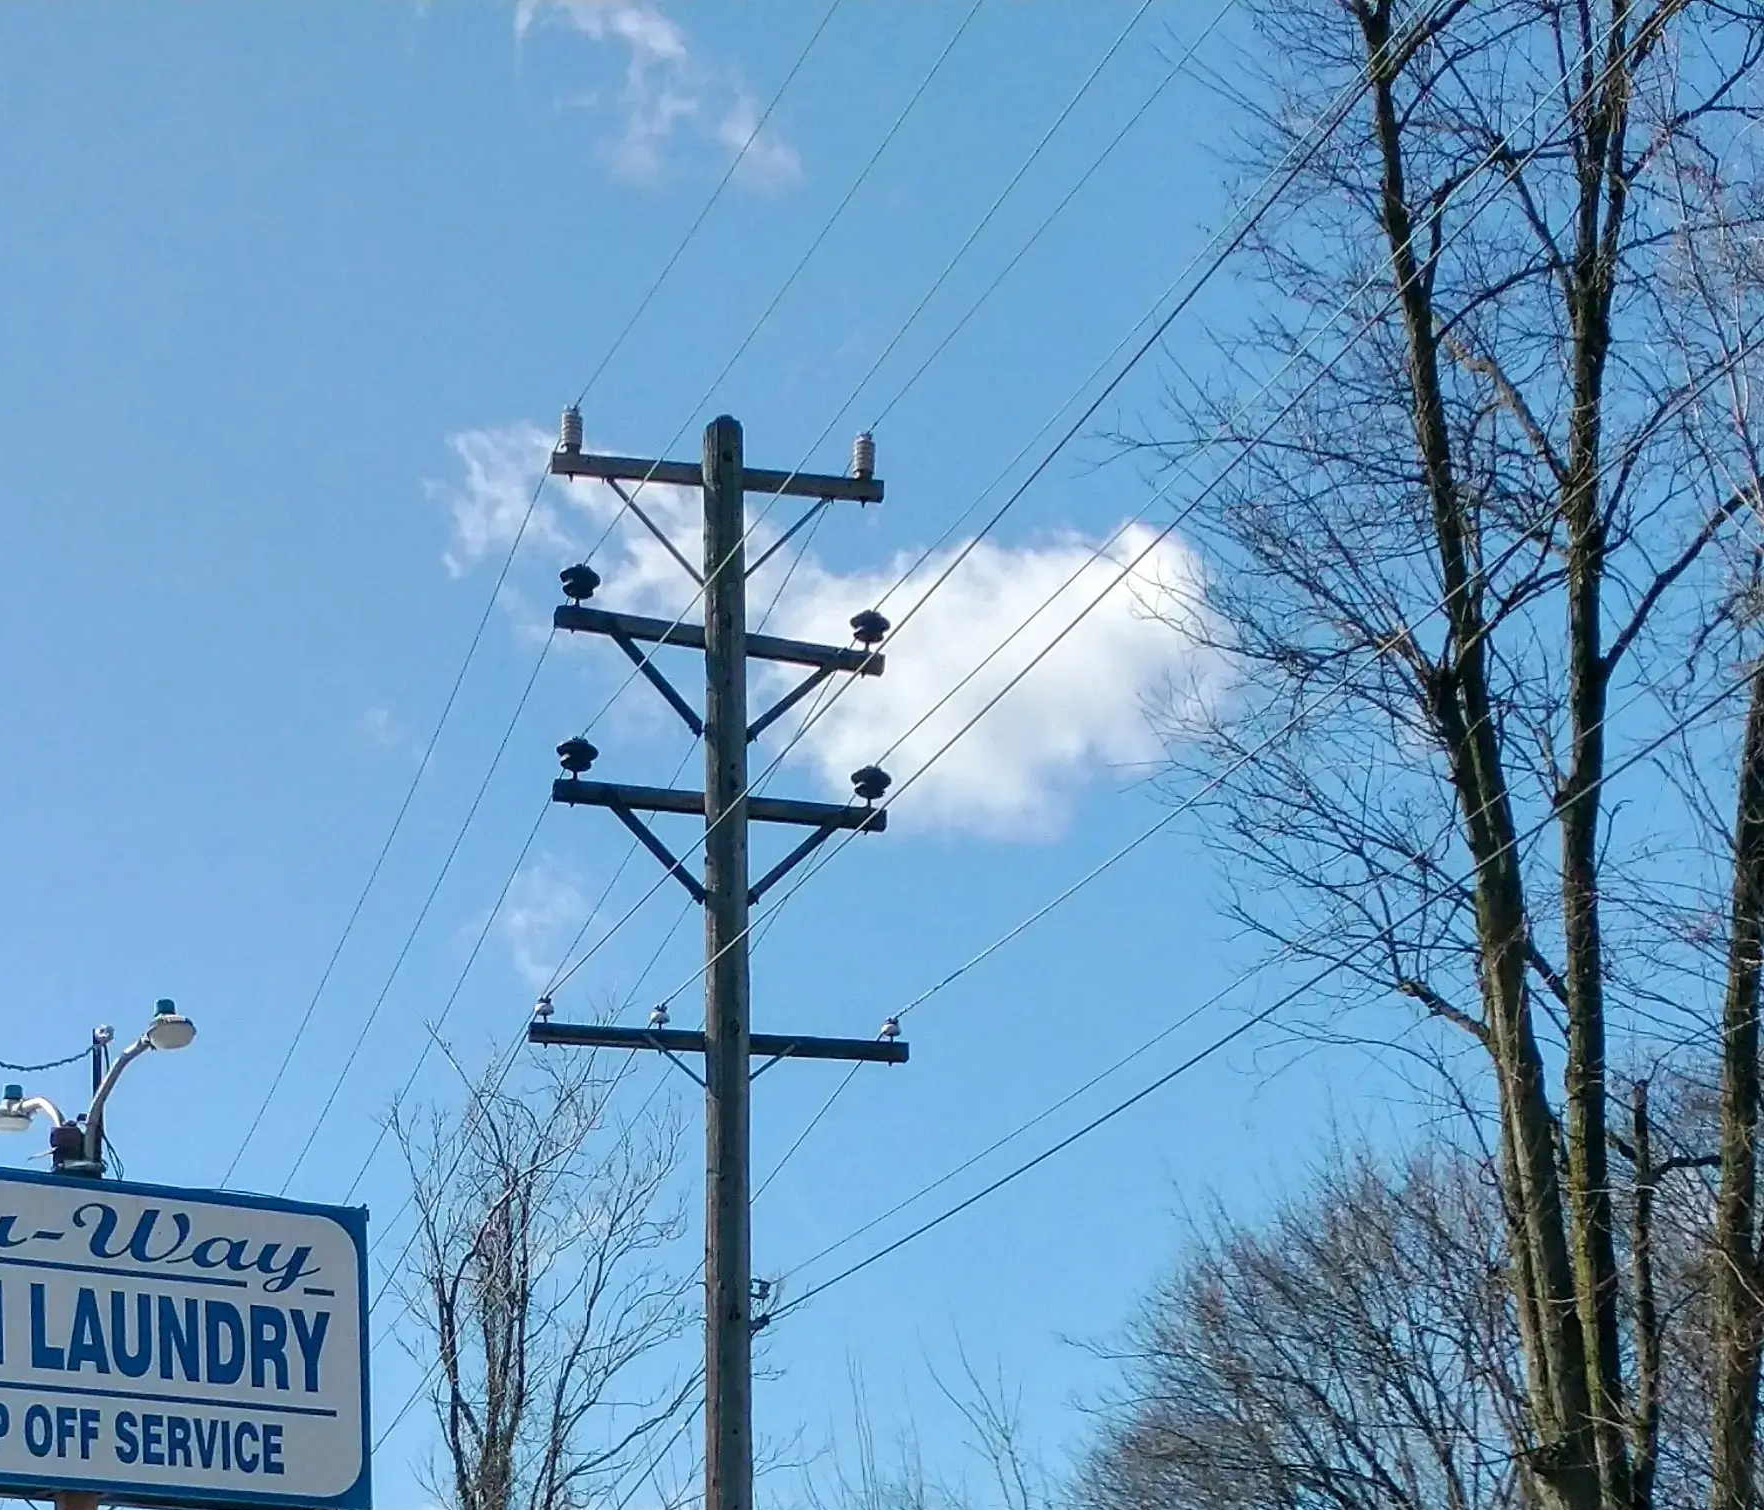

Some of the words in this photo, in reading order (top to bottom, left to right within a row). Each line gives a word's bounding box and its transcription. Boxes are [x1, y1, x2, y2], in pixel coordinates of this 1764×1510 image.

[29, 1283, 331, 1393] LAUNDRY
[24, 1404, 102, 1461] OFF
[115, 1410, 285, 1476] SERVICE
